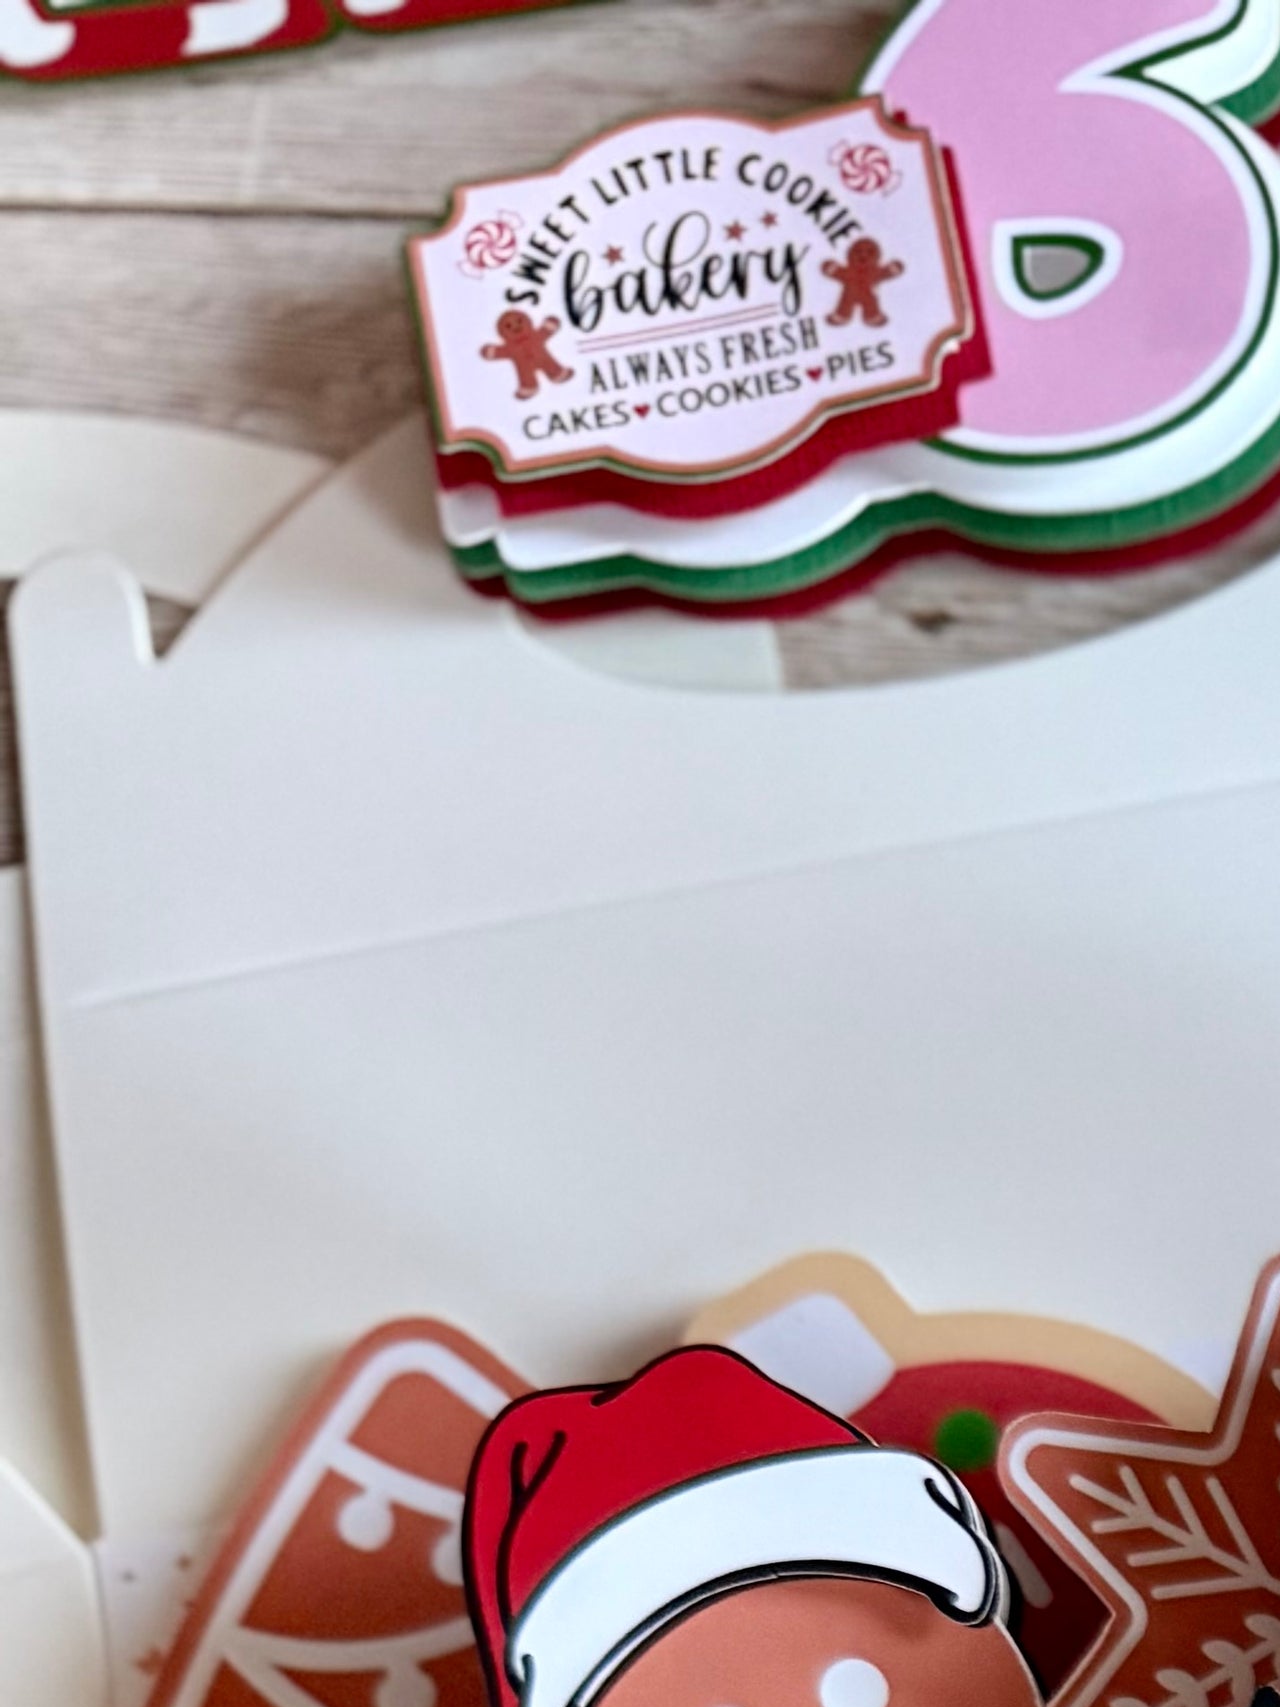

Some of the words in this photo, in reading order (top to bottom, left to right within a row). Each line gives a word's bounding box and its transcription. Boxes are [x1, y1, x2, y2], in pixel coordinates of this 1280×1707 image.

[504, 186, 590, 306] SWEET
[589, 147, 722, 206] LITTLE
[737, 153, 864, 249] COOKIE
[561, 210, 811, 333] bakery
[522, 402, 631, 441] CAKES
[656, 366, 802, 419] COOKIES
[827, 341, 896, 381] PIES
[588, 340, 712, 395] ALWAYS
[722, 317, 820, 371] FRESH
